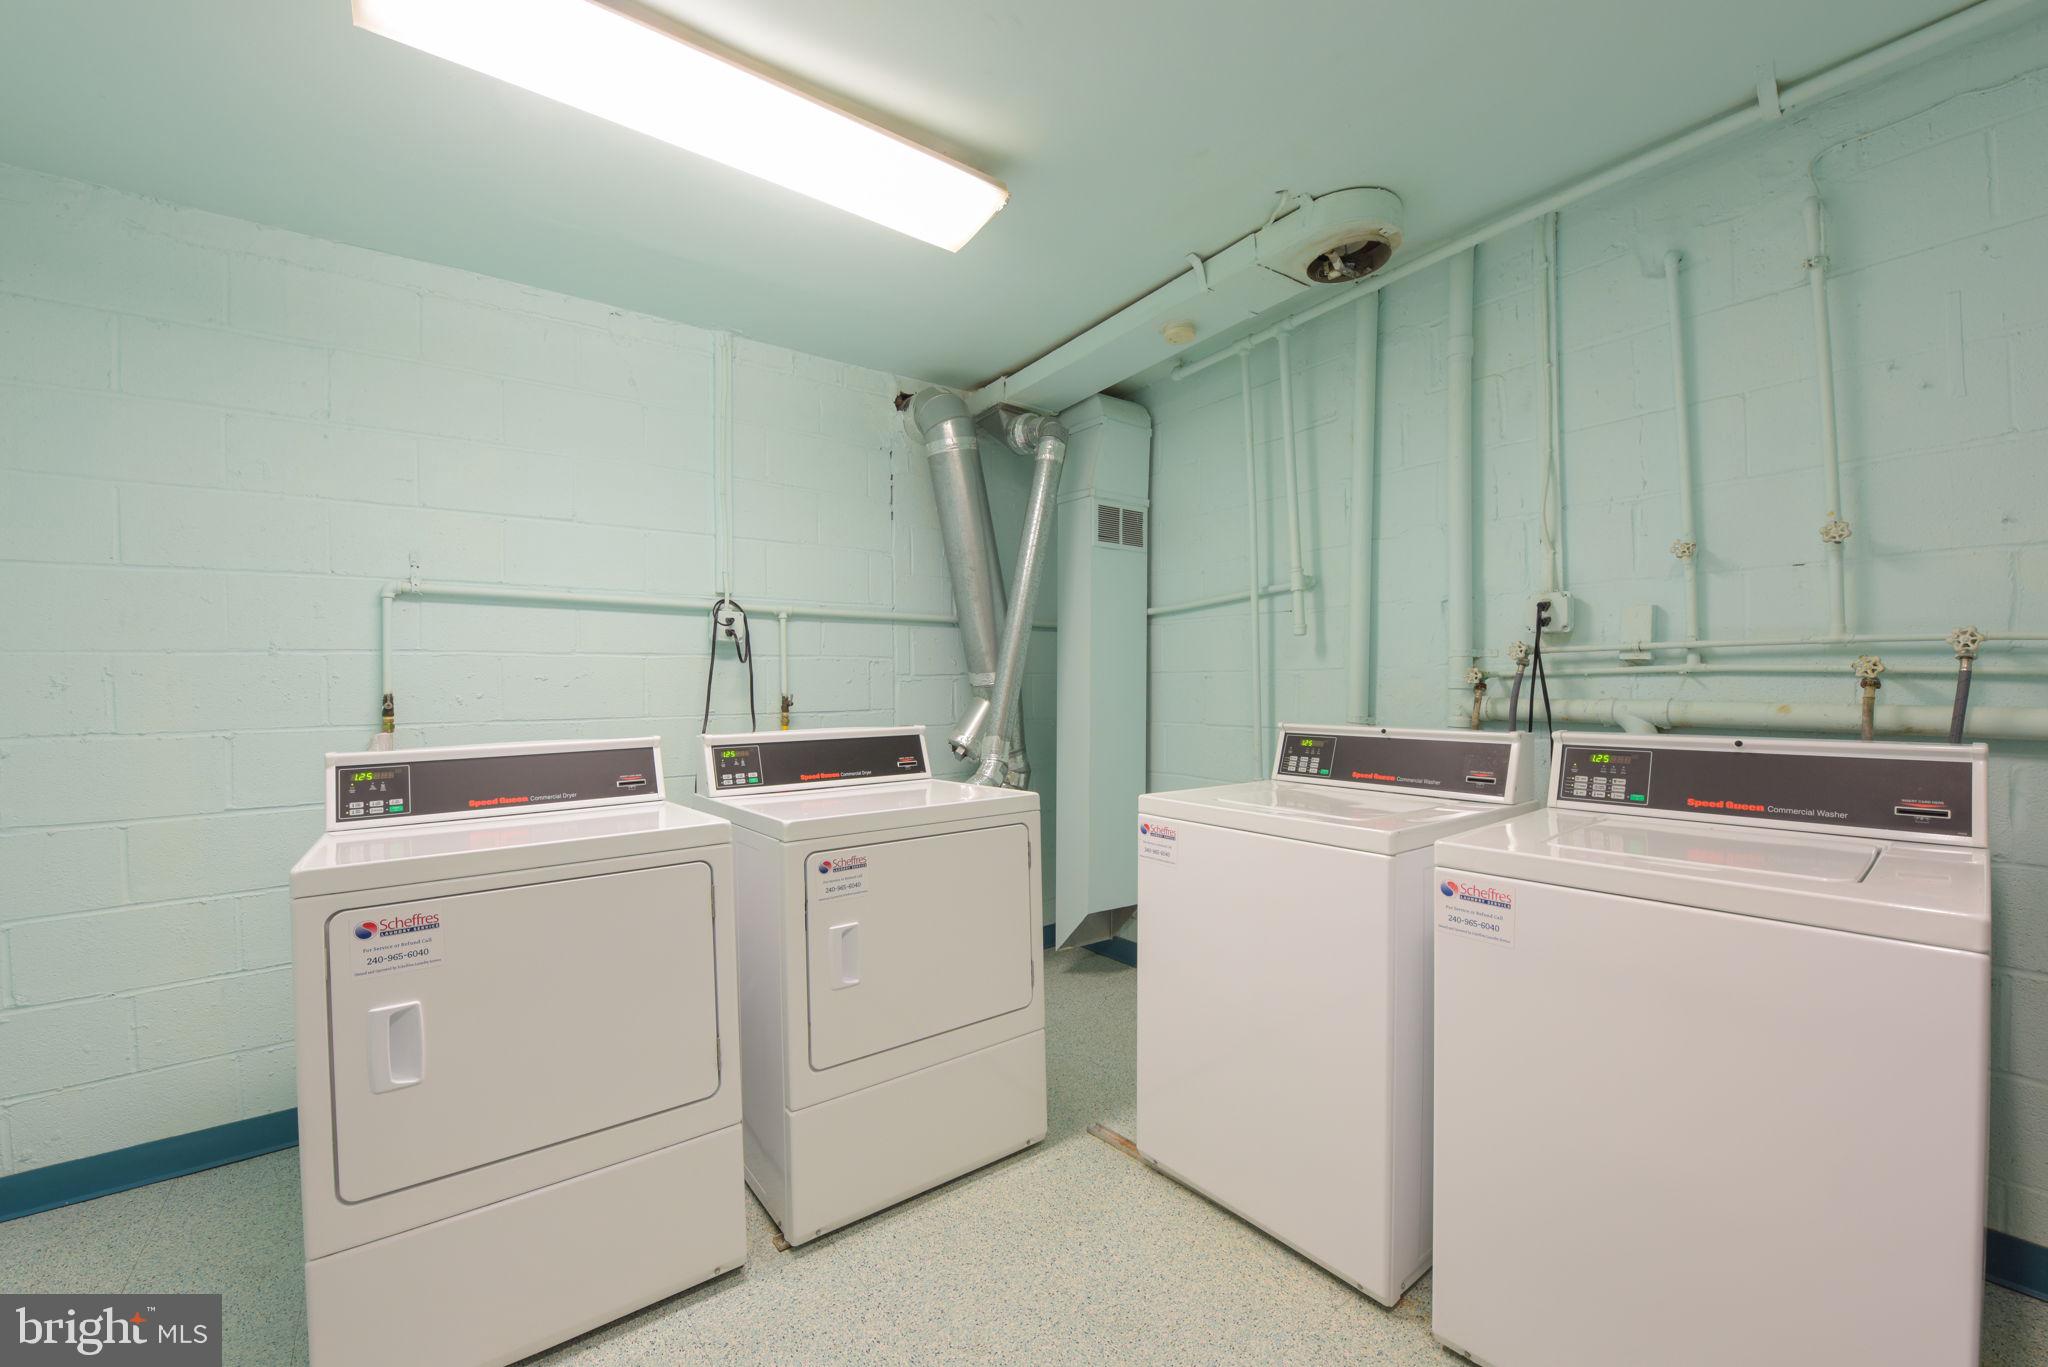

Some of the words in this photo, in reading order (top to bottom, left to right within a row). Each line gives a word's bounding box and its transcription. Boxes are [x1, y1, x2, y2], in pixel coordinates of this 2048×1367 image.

[800, 772, 820, 780] Speed
[1352, 771, 1373, 780] Speed
[1373, 773, 1395, 782] Queen
[1397, 776, 1423, 784] Commercial
[469, 797, 498, 807] Speed
[500, 796, 528, 804] Queen
[530, 793, 561, 802] Commercial
[562, 792, 577, 800] Dryer
[1687, 798, 1724, 808] Speed
[1726, 801, 1765, 812] Queen
[1767, 805, 1815, 816] Commercial
[1816, 810, 1848, 819] Washer
[1150, 824, 1176, 836] Scheffres
[832, 855, 867, 867] Scheffres
[825, 882, 861, 893] 240-965-6040
[1460, 883, 1512, 903] Scheffres
[1460, 895, 1485, 904] LAUNDRY
[1488, 900, 1511, 909] SERVICE
[380, 913, 439, 931] Scheffres
[1448, 915, 1500, 932] 240-965-6040
[380, 929, 410, 937] LAUNDRY
[414, 923, 439, 931] SERVICE
[367, 948, 429, 965] 240-965-6040
